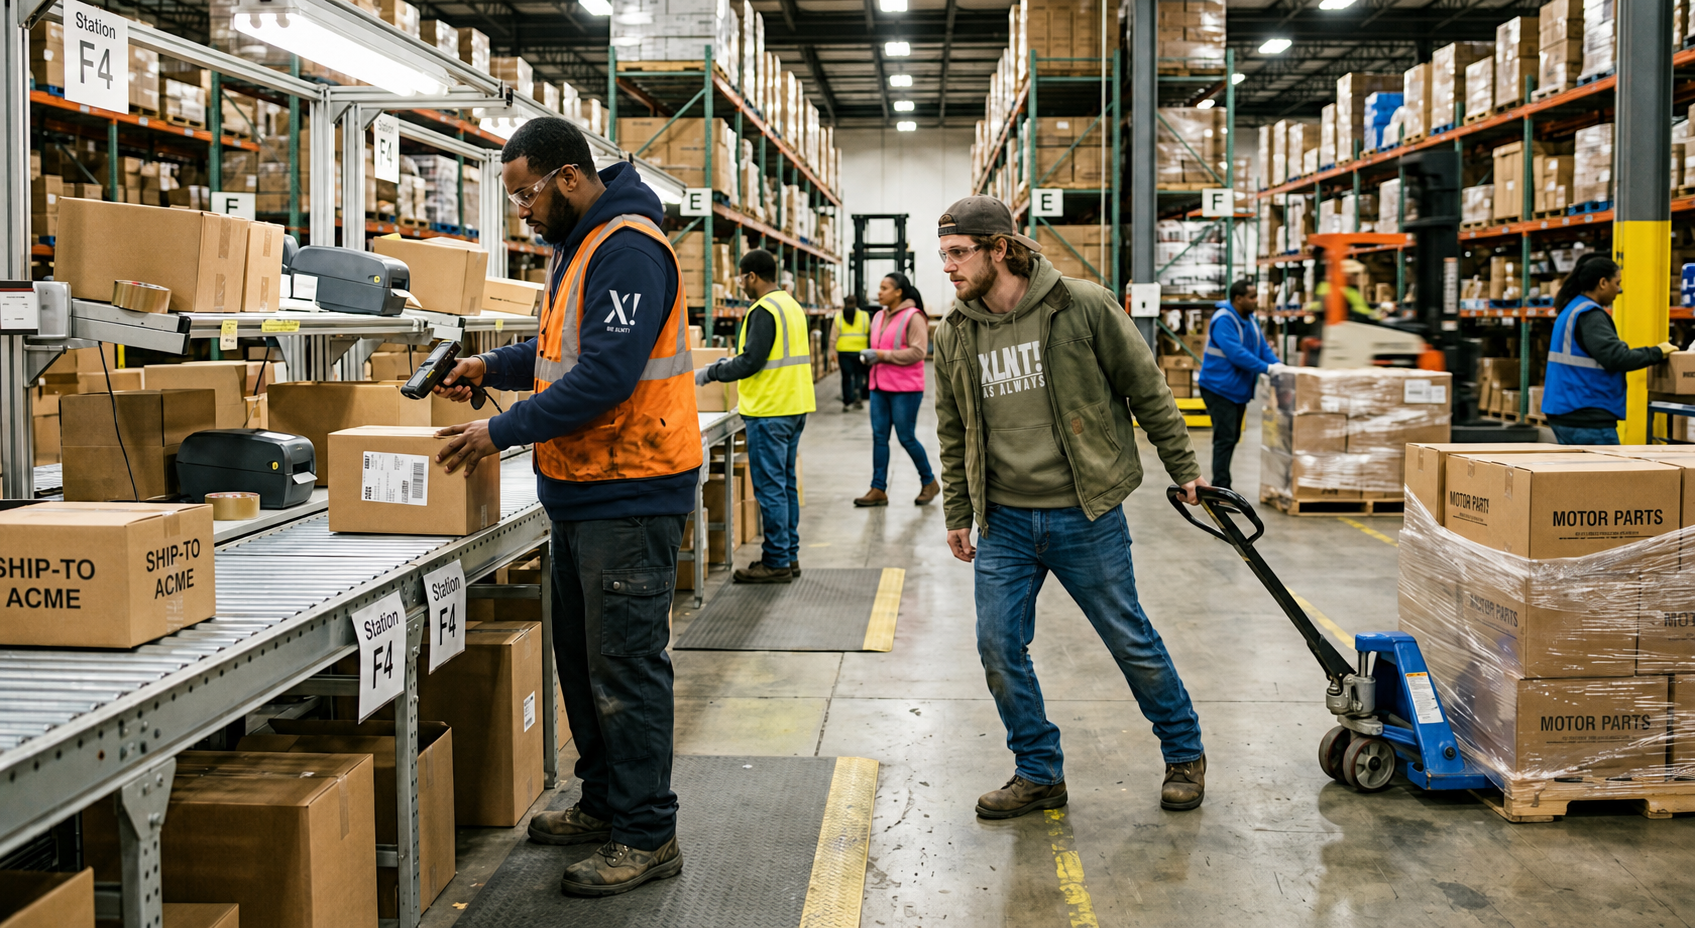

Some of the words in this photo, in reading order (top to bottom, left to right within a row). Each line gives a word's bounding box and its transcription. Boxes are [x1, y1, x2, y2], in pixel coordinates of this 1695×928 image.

[76, 11, 116, 40] Station
[79, 39, 114, 90] F4
[380, 138, 392, 168] F4
[226, 198, 239, 214] F
[690, 193, 702, 210] E
[1041, 193, 1053, 211] E
[1212, 193, 1224, 211] F
[603, 289, 642, 326] X!
[978, 341, 1042, 385] XLNT!
[982, 386, 995, 399] AS
[1000, 375, 1046, 396] ALWAYS
[1450, 490, 1471, 510] MOTOR
[1552, 510, 1609, 527] MOTOR
[1613, 508, 1664, 526] PARTS
[146, 538, 201, 572] SHIP-TO
[154, 568, 195, 600] ACME
[432, 576, 460, 601] Station
[6, 587, 81, 609] ACME
[364, 611, 399, 640] Station
[440, 603, 456, 646] F4
[1496, 603, 1518, 628] PARTS
[372, 640, 393, 690] F4
[1540, 715, 1596, 732] MOTOR
[1601, 713, 1651, 731] PARTS
